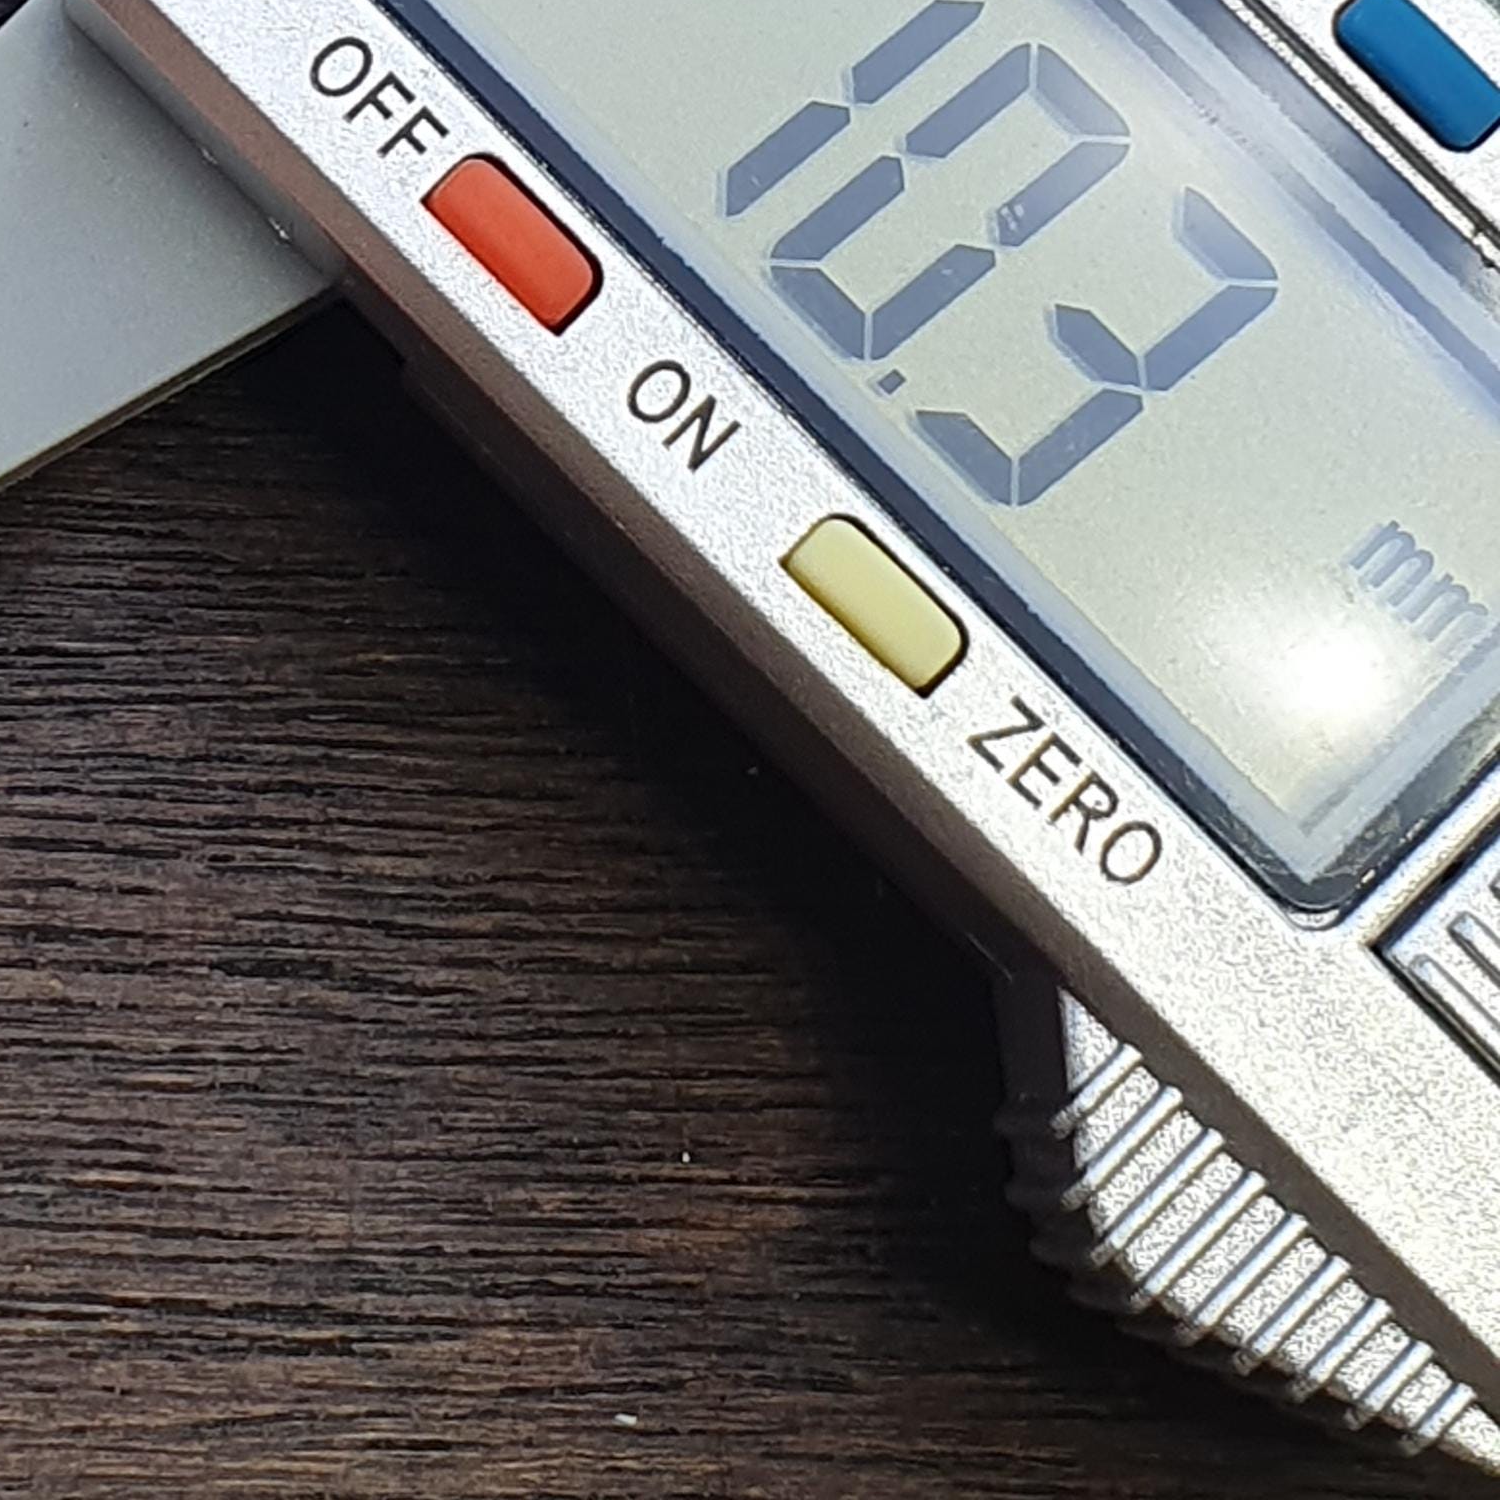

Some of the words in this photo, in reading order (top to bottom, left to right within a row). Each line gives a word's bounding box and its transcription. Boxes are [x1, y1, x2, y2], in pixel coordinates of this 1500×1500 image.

[308, 36, 450, 159] OFF
[626, 359, 741, 475] ON
[1346, 520, 1489, 642] mm
[966, 694, 1163, 886] ZERO
